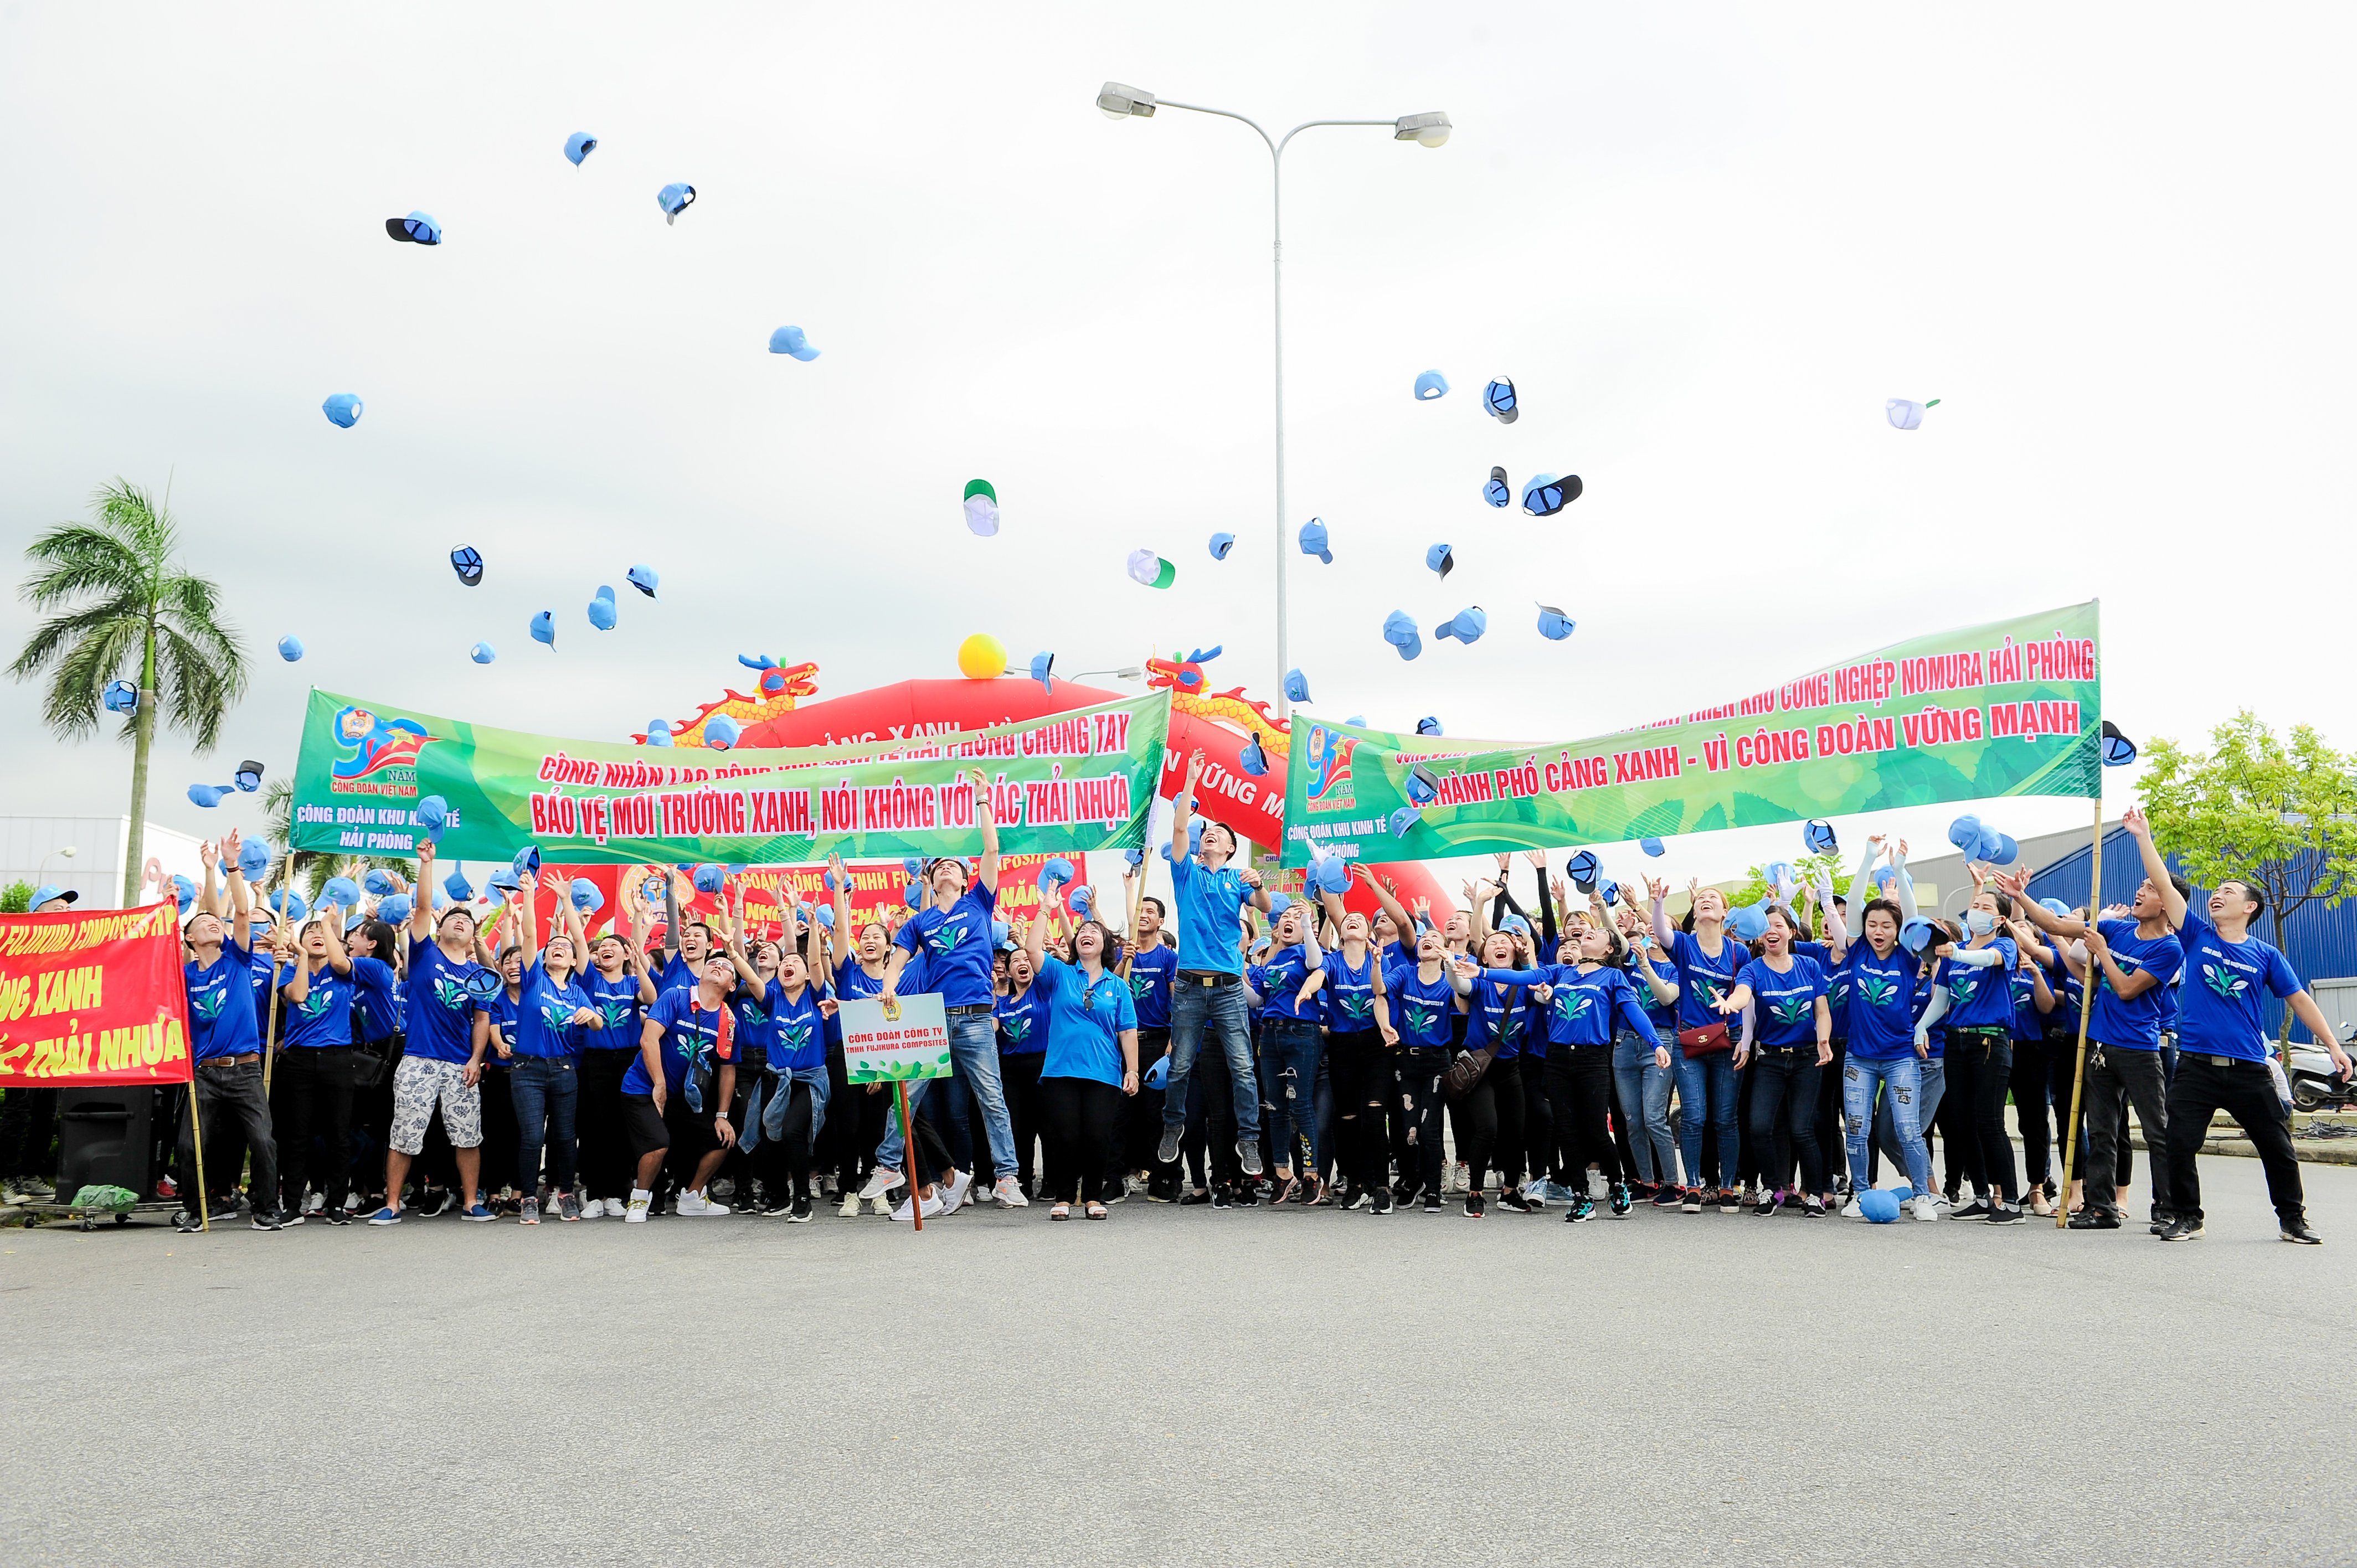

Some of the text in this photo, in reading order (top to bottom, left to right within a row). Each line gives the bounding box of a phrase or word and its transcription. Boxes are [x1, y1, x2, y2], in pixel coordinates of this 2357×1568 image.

[1835, 657, 1896, 706] NGHỆP
[1901, 652, 1984, 696] NOMURA
[1989, 636, 2022, 684] HẢI
[2026, 631, 2095, 680] PHÒNG
[1094, 714, 1129, 753] TAY
[1434, 770, 1493, 806] HÀNH
[1495, 755, 1539, 798] PHỐ
[1545, 751, 1609, 792] CẢNG
[1613, 746, 1680, 783] XANH
[1704, 733, 1728, 771] VÌ
[1736, 728, 1809, 767] CÔNG
[1817, 715, 1895, 757] ĐOÀN
[1902, 706, 1982, 747] VỮNG
[1990, 702, 2080, 740] MẠNH
[388, 768, 416, 782] NĂM
[539, 752, 600, 785] CÔNG
[603, 760, 663, 788] NHÂN
[332, 780, 416, 798] CÔNG ĐOÀN VIỆT NAM
[1201, 762, 1257, 805] ỮNG
[1335, 783, 1354, 796] NĂM
[297, 803, 333, 823] CÔNG
[336, 804, 376, 825] ĐOÀN
[378, 808, 406, 826] KHU
[445, 808, 461, 828] TẾ
[532, 787, 575, 834] BẢO
[580, 796, 606, 842] VỆ
[613, 792, 655, 835] MÔI
[660, 785, 745, 835] TRƯỜNG
[751, 790, 815, 837] XANH,
[822, 781, 858, 831] NÓI
[864, 778, 935, 829] KHÔNG
[940, 773, 973, 826] VỚI
[1026, 765, 1069, 823] THẢI
[1074, 774, 1129, 828] NHỰA
[1307, 797, 1355, 812] CÔNG ĐOÀN VIỆT NAM
[339, 826, 414, 850] HẢI PHÒNG
[1287, 823, 1310, 841] CÔNG
[1310, 821, 1332, 839] ĐOÀN
[1332, 822, 1351, 837] KHU
[1351, 820, 1374, 836] KINH
[1330, 841, 1360, 859] PHÒNG
[29, 965, 103, 1017] XANH
[24, 1018, 93, 1078] THẢI
[97, 1013, 187, 1077] NHỰA
[846, 1039, 948, 1054] TNHH FUJIKURA COMPOSITES
[848, 1027, 943, 1043] CÔNG ĐOÀN CÔNG TY
